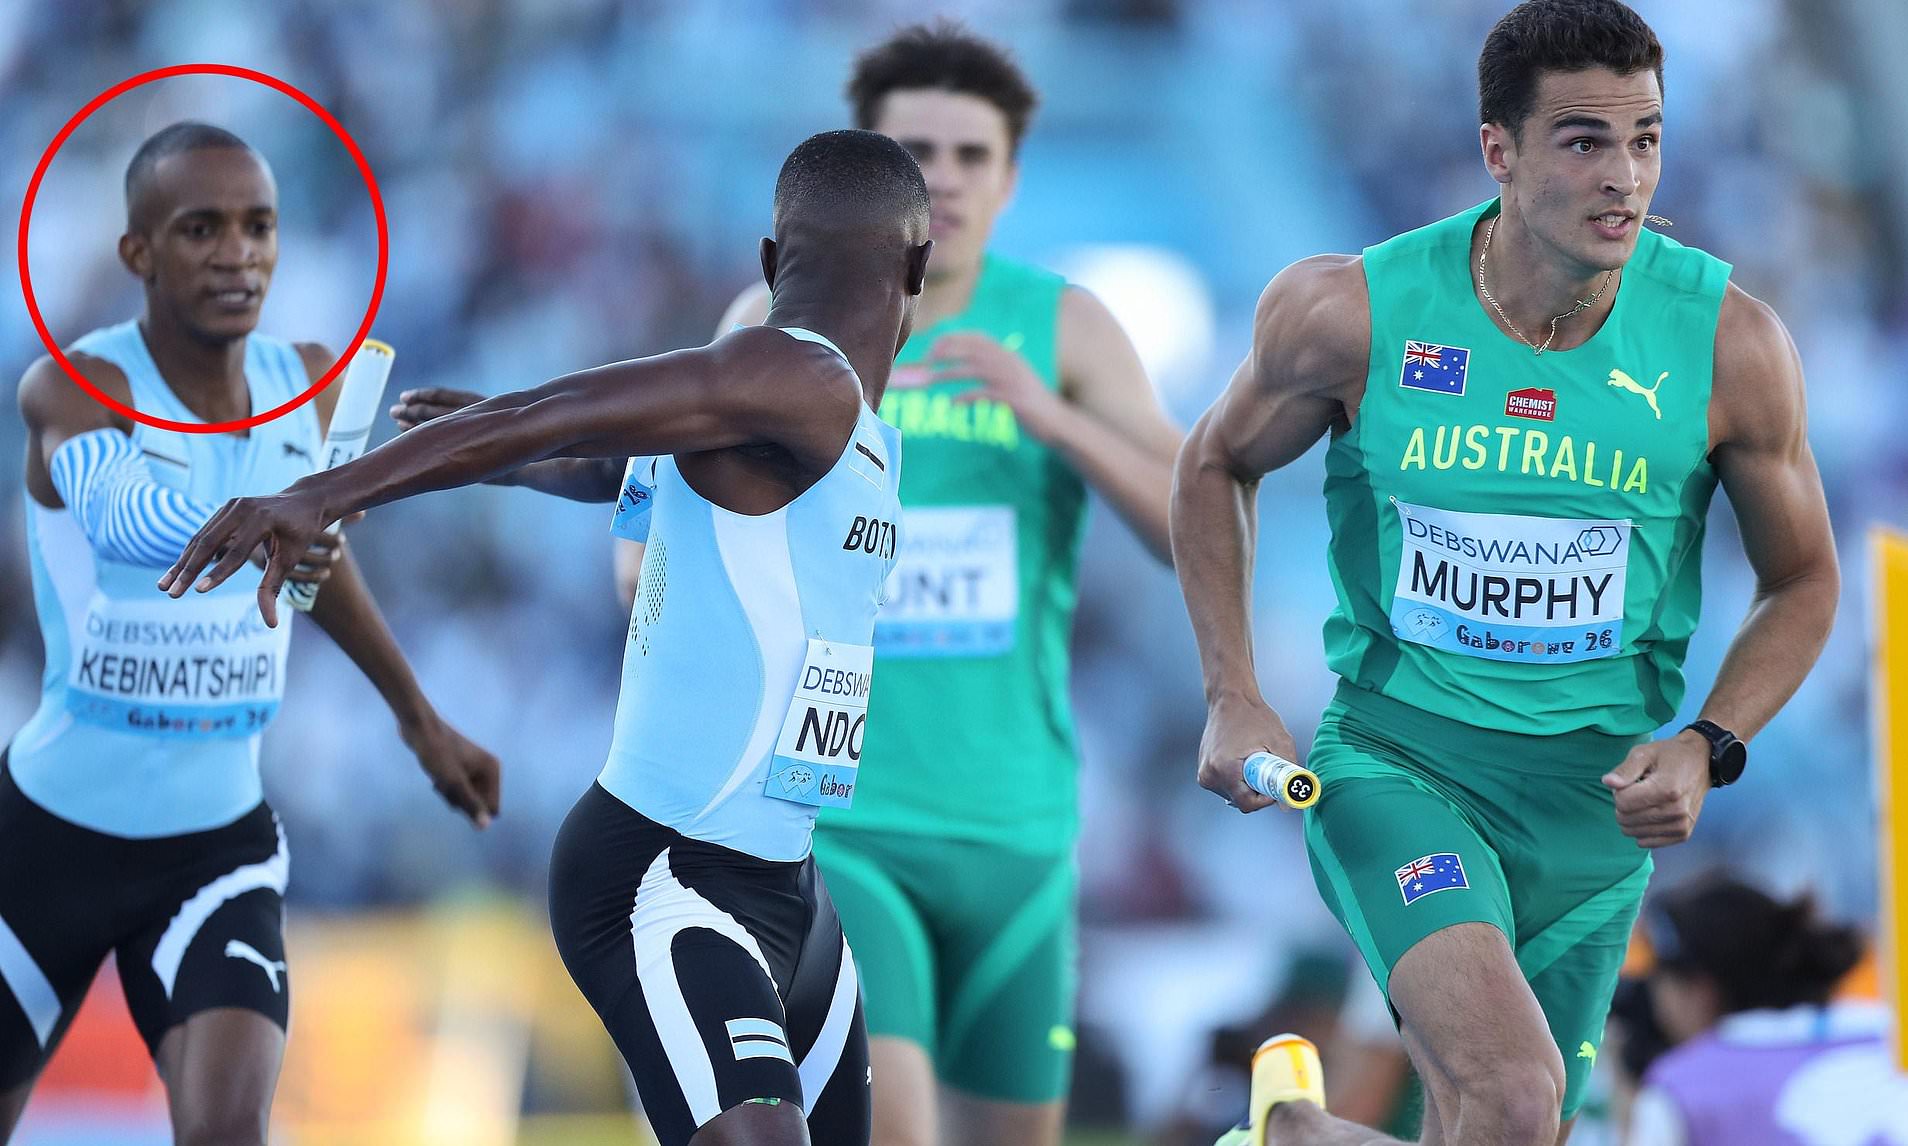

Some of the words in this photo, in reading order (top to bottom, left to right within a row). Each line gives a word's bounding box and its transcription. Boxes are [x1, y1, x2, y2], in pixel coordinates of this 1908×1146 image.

[1508, 406, 1552, 417] WAREHOUSE
[1509, 395, 1554, 411] CHEMIST
[1400, 425, 1648, 494] AUSTRALIA
[1407, 517, 1583, 564] DEBSWANA
[1411, 550, 1613, 620] MURPHY
[86, 612, 245, 645] DEBSWANA
[1456, 624, 1575, 655] Gaborone
[1585, 629, 1613, 651] 26
[78, 647, 277, 698] KEBINATSHIPI
[1290, 779, 1311, 798] 33
